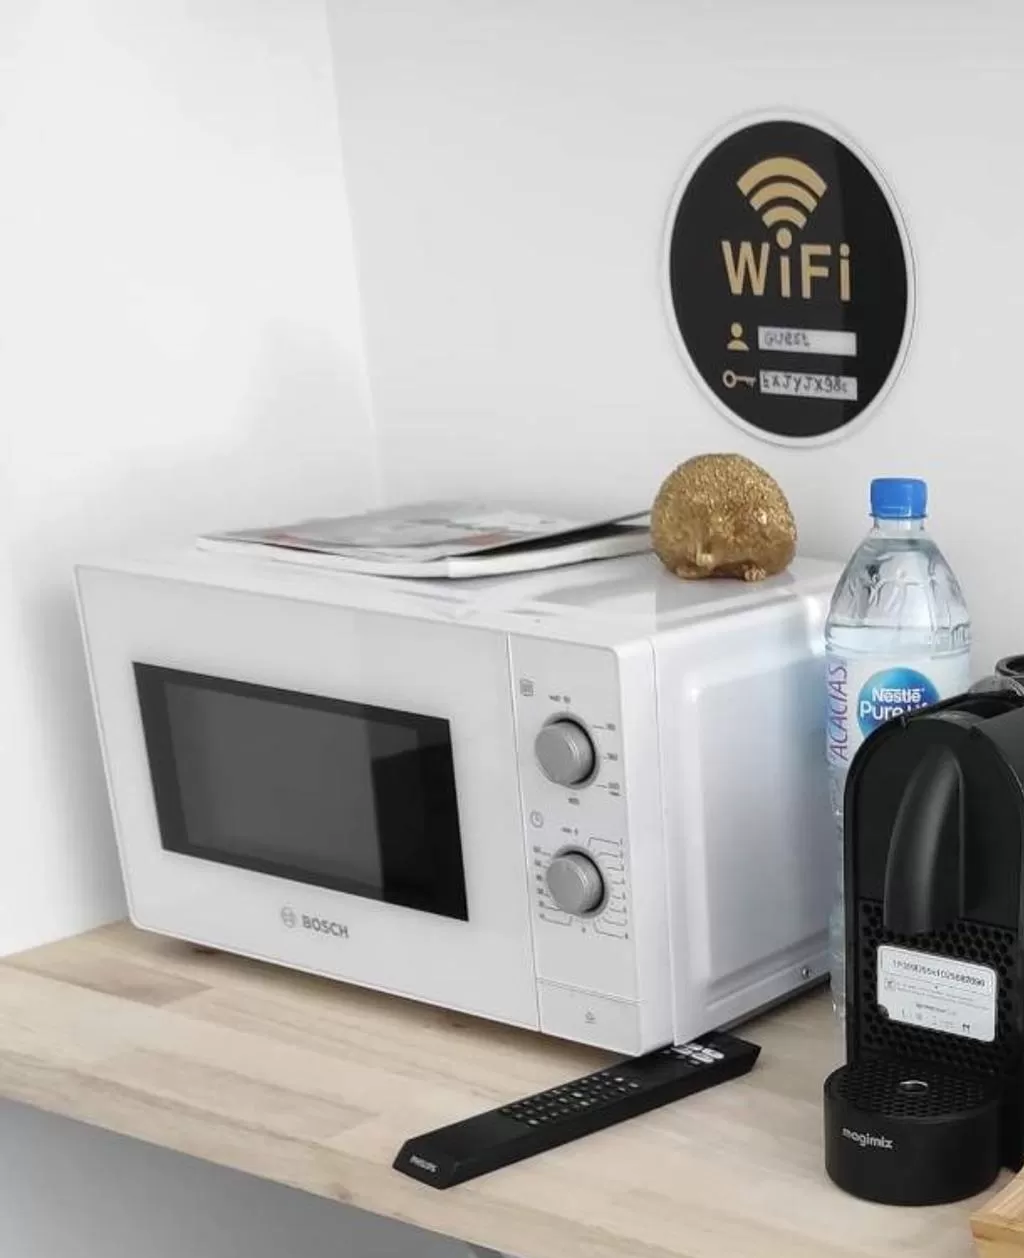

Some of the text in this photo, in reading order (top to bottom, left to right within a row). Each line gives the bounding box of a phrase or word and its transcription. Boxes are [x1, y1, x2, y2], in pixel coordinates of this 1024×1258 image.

[721, 227, 852, 302] WiFi
[871, 687, 922, 704] Nestlé
[301, 913, 349, 939] BOSCH
[842, 1127, 894, 1149] magimix
